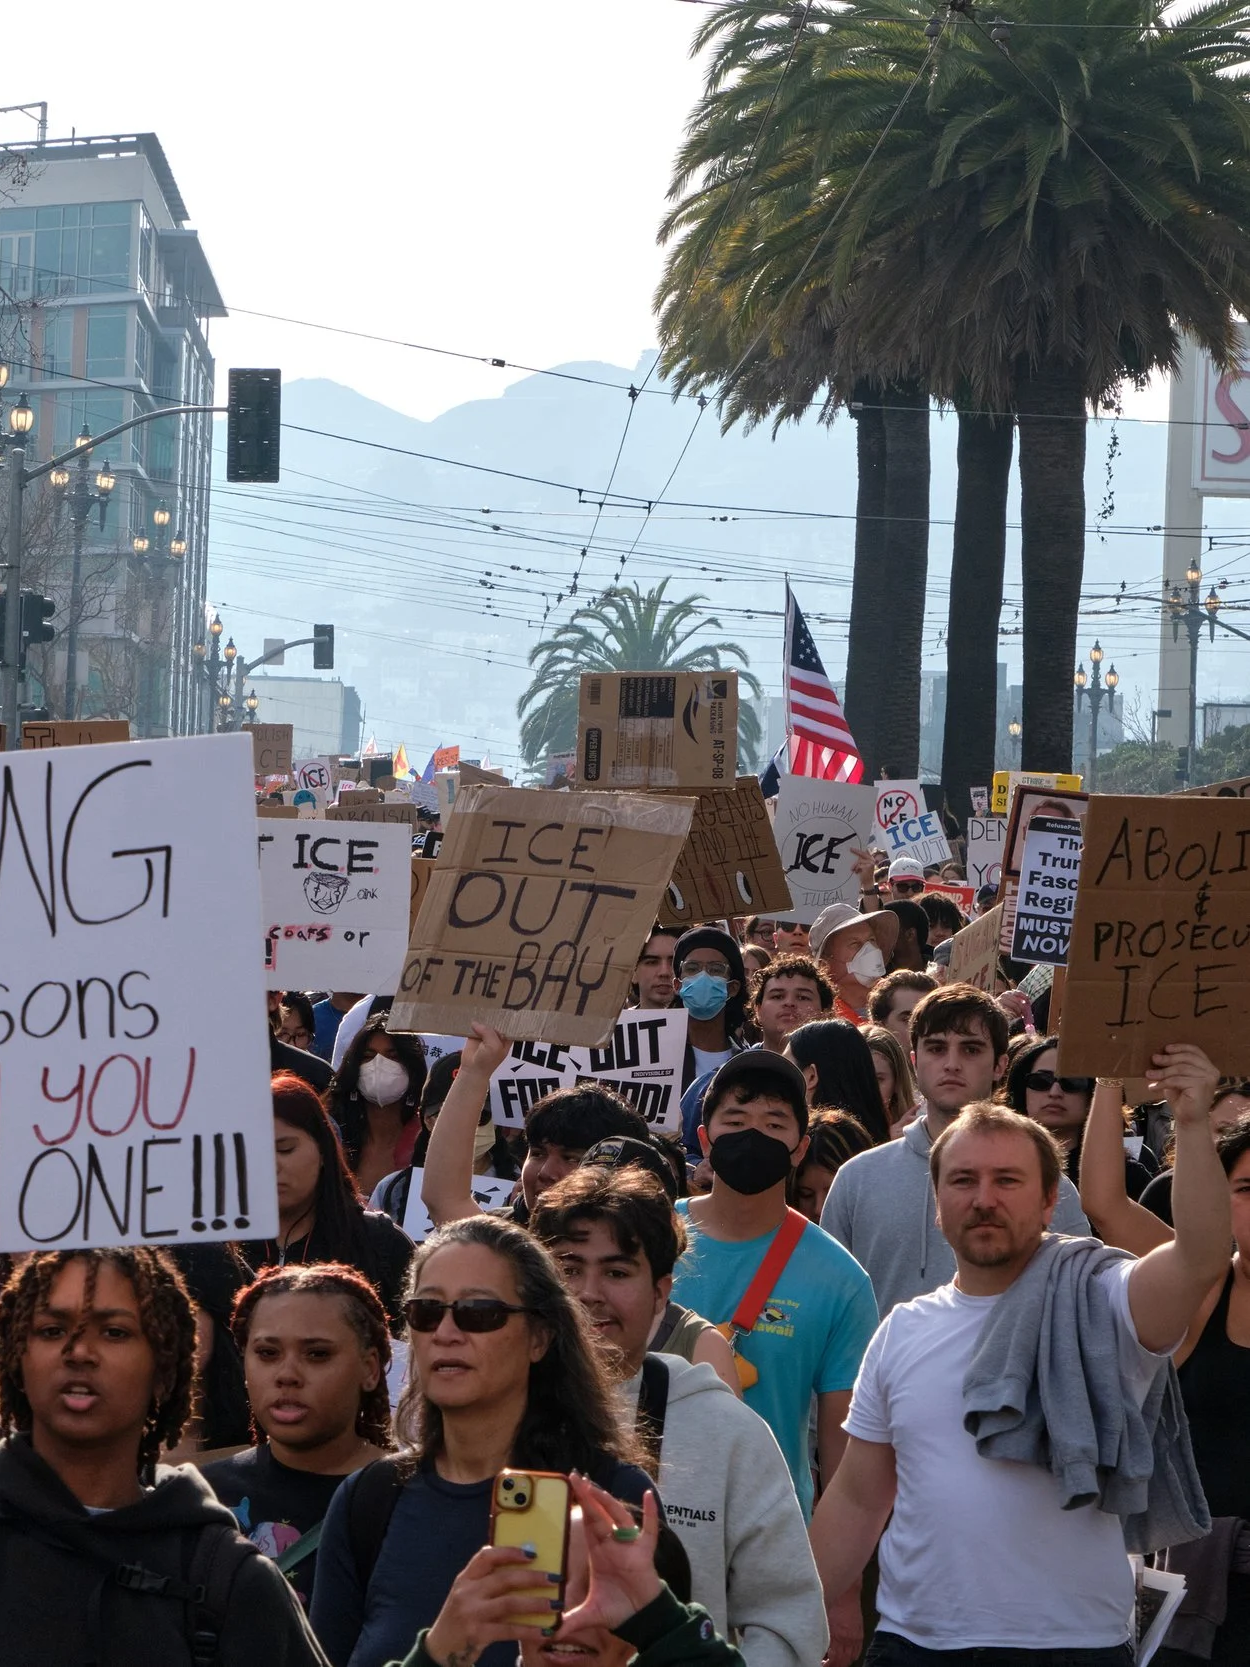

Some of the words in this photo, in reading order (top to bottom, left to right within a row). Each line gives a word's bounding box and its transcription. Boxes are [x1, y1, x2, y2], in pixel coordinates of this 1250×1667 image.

[712, 739, 725, 780] AT-SP-08
[302, 767, 327, 789] ICE
[588, 763, 598, 779] CUPS
[789, 802, 810, 823] NO
[812, 800, 859, 822] HUMAN
[883, 796, 906, 809] NO
[883, 813, 908, 826] ICE
[885, 813, 939, 850] ICE
[482, 820, 604, 873] ICE
[789, 832, 842, 875] ICE
[447, 870, 637, 946] OUT
[802, 890, 850, 907] ILLEGAL
[1018, 916, 1073, 937] MUST
[343, 929, 371, 948] or
[400, 957, 444, 995] OF
[452, 959, 507, 999] THE
[501, 940, 614, 1017] BAY
[588, 1018, 668, 1073] OUT
[633, 1069, 665, 1077] INDIVISIBLE
[18, 1132, 250, 1243] ONE!!!
[663, 1504, 717, 1522] ENTIALS
